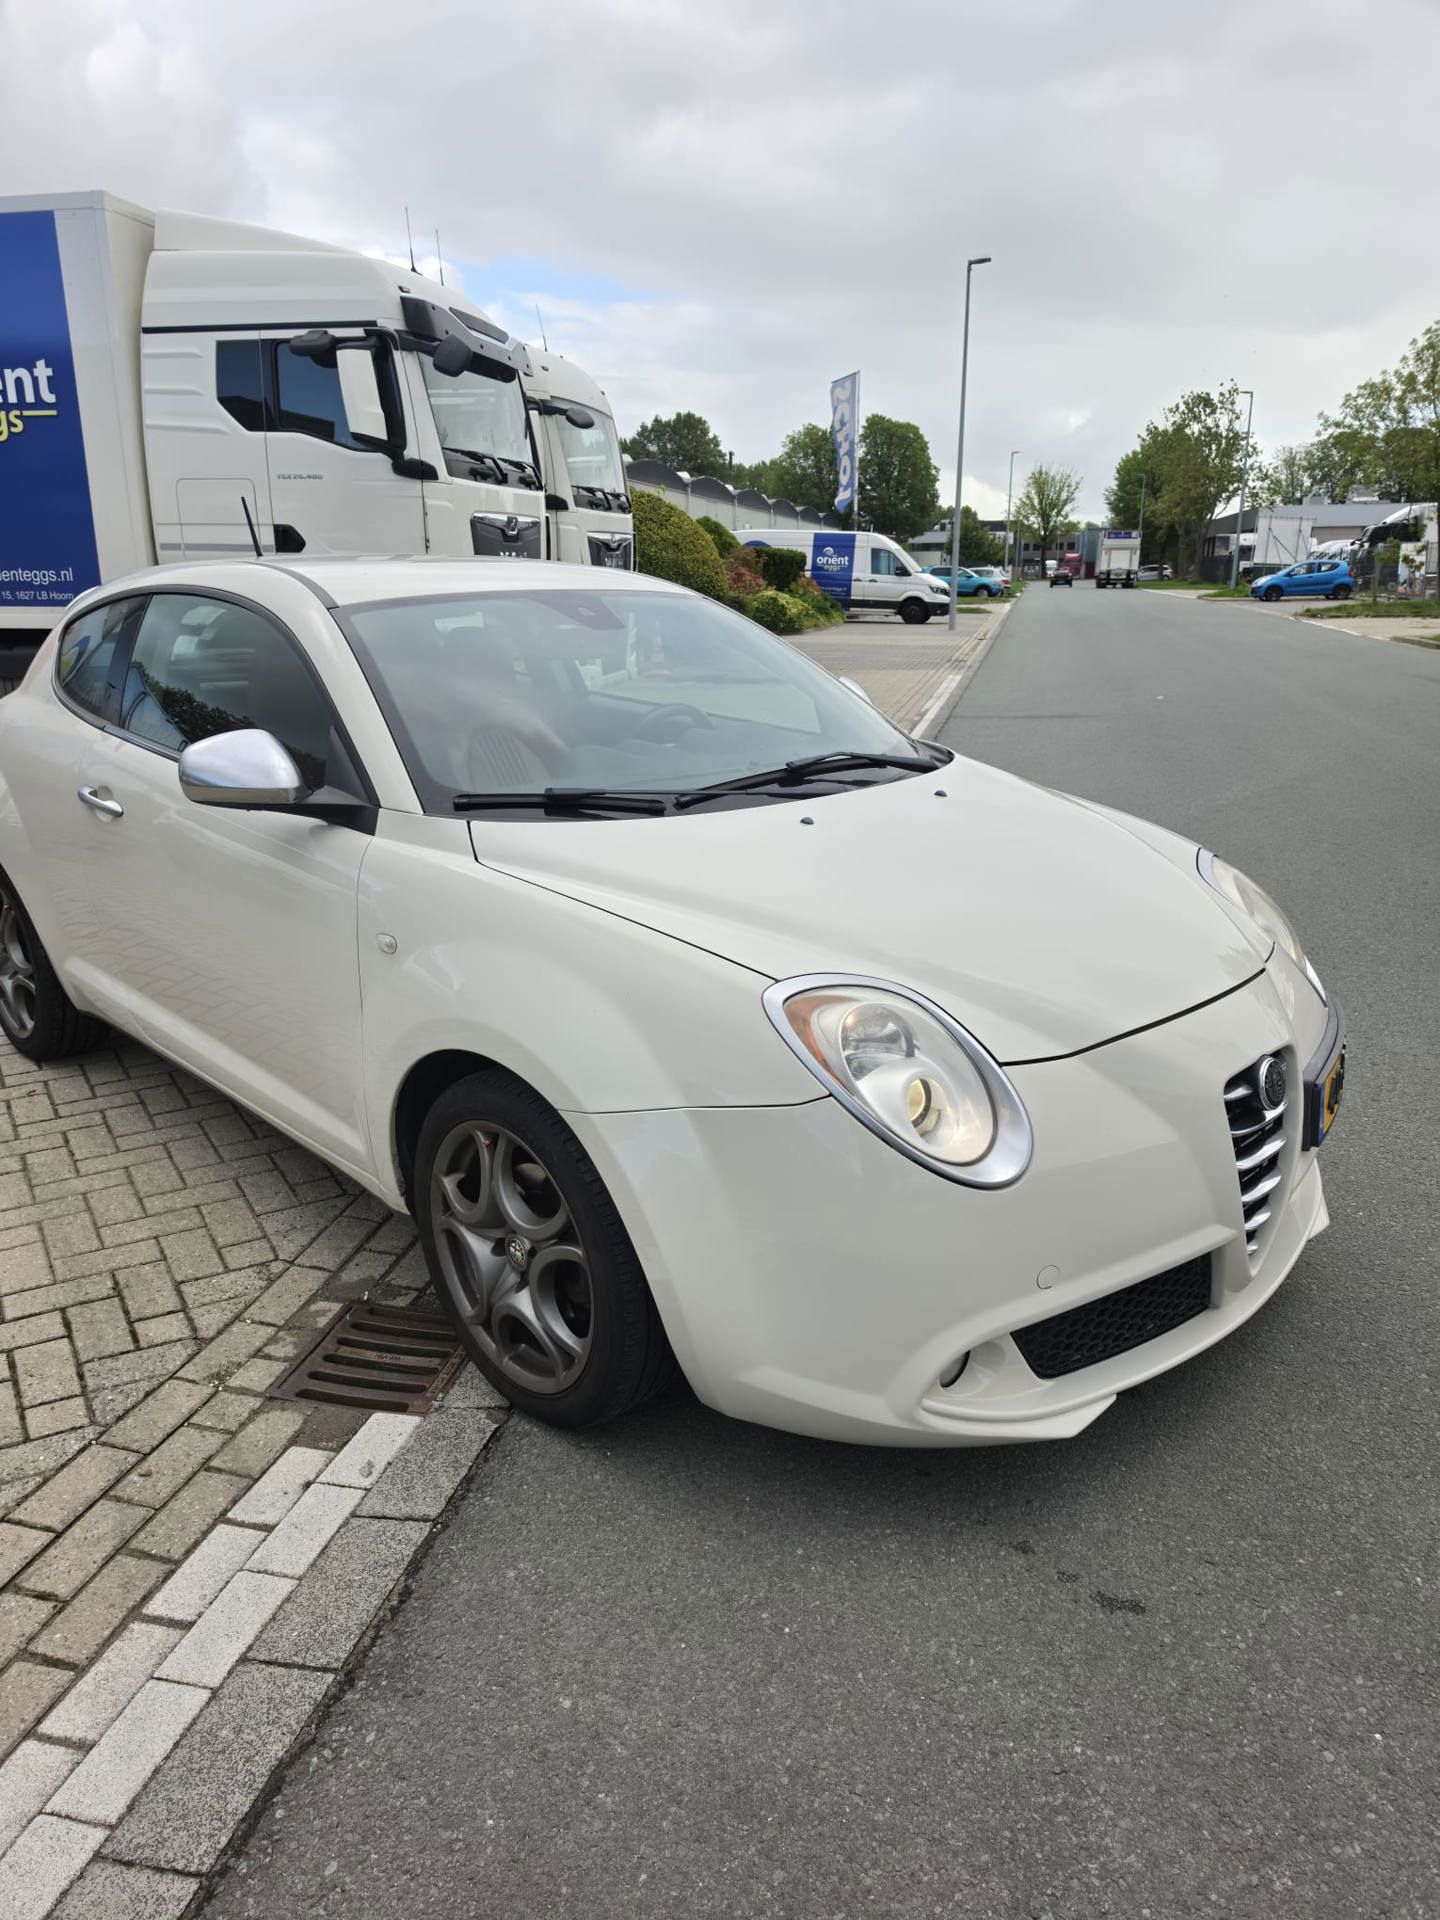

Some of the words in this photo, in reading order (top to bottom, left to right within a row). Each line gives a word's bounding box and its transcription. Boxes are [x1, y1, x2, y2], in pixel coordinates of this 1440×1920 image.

[816, 554, 849, 565] oriënt
[16, 591, 34, 600] 1627
[36, 591, 48, 600] LB
